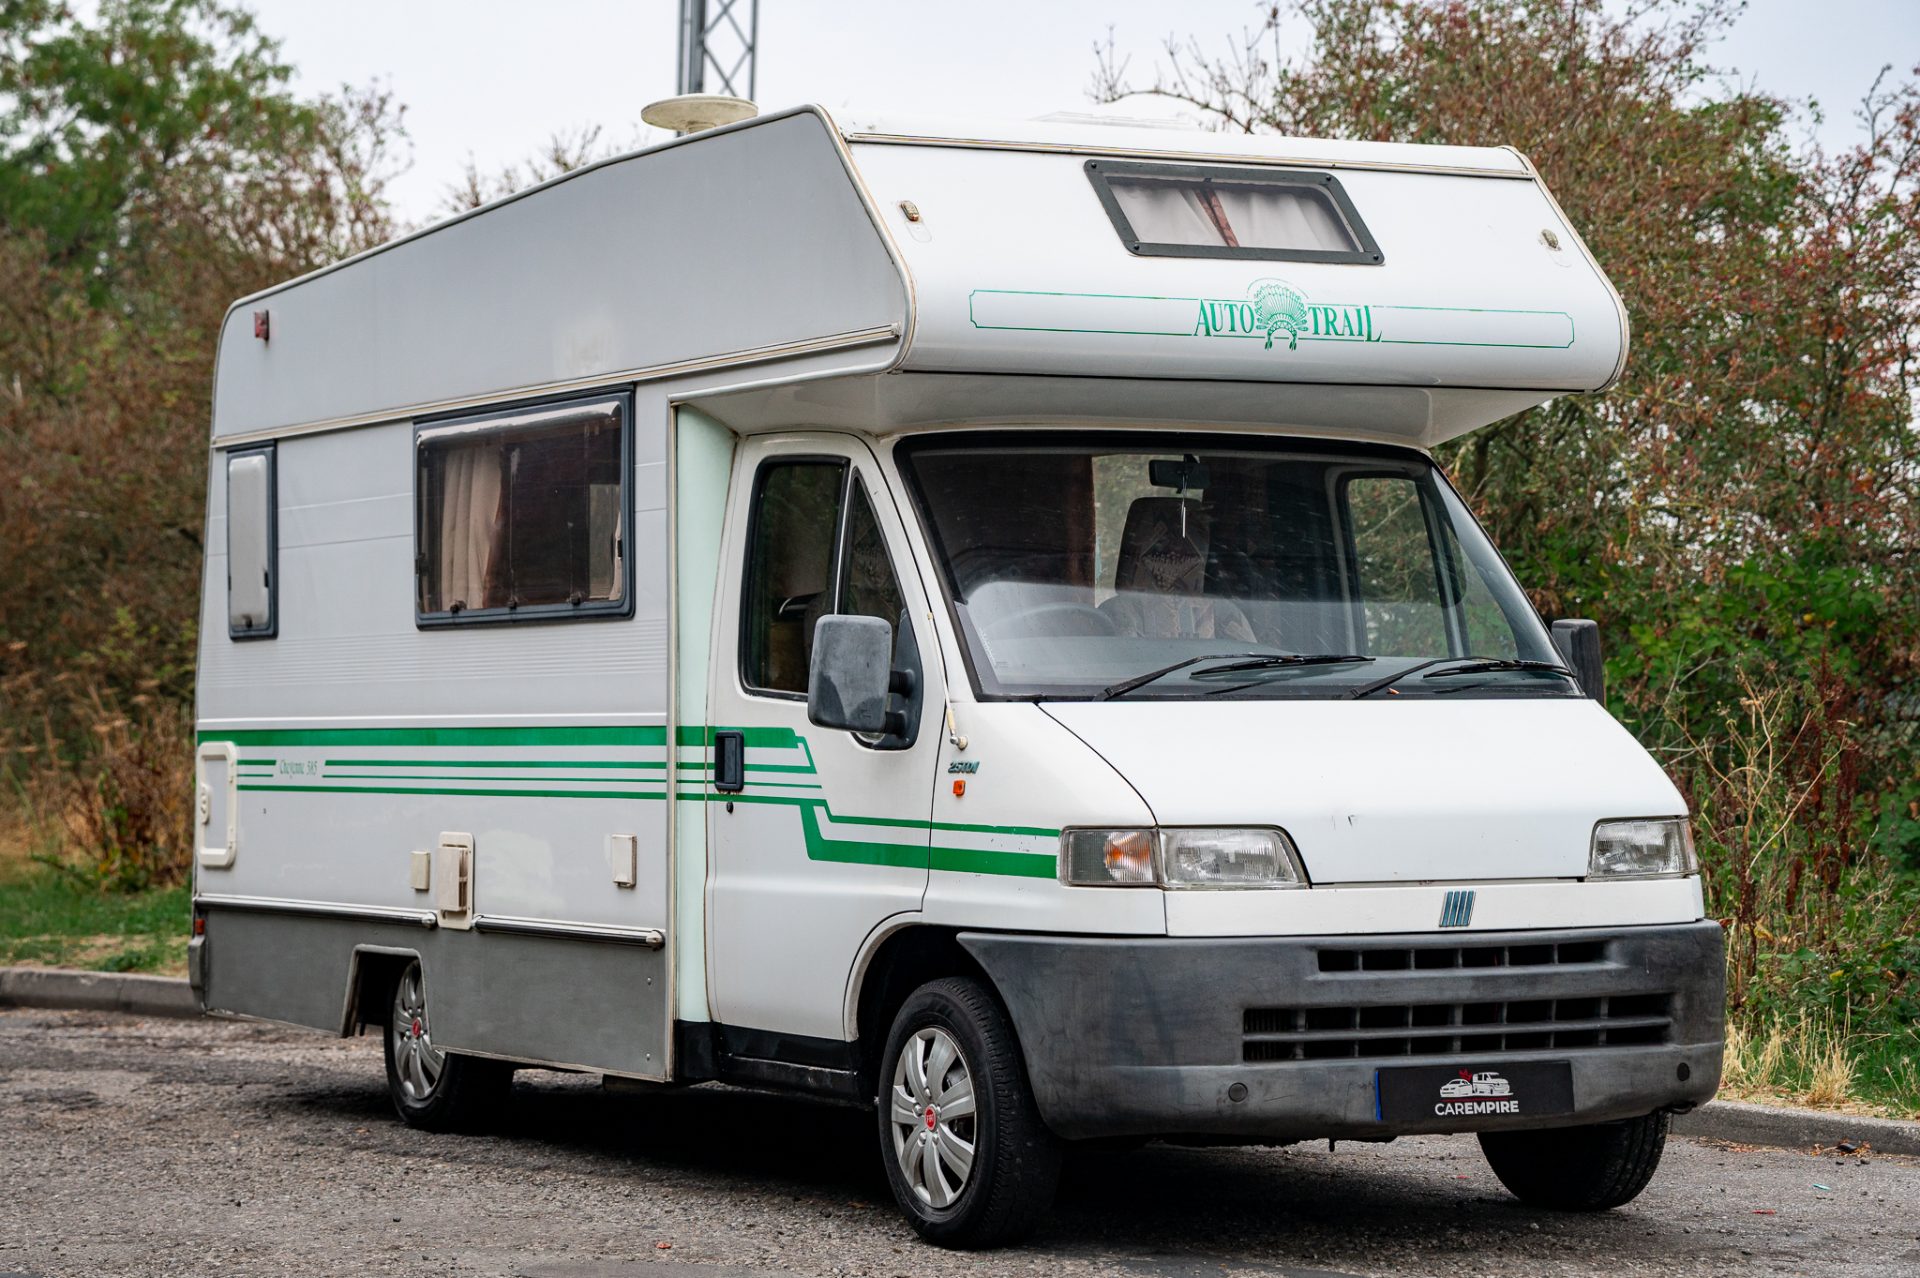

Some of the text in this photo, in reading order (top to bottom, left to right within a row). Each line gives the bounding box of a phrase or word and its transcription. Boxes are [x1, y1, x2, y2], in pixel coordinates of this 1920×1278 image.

[1193, 299, 1382, 343] AUTO TRAIL
[1435, 1100, 1519, 1116] CAREMPIRE
